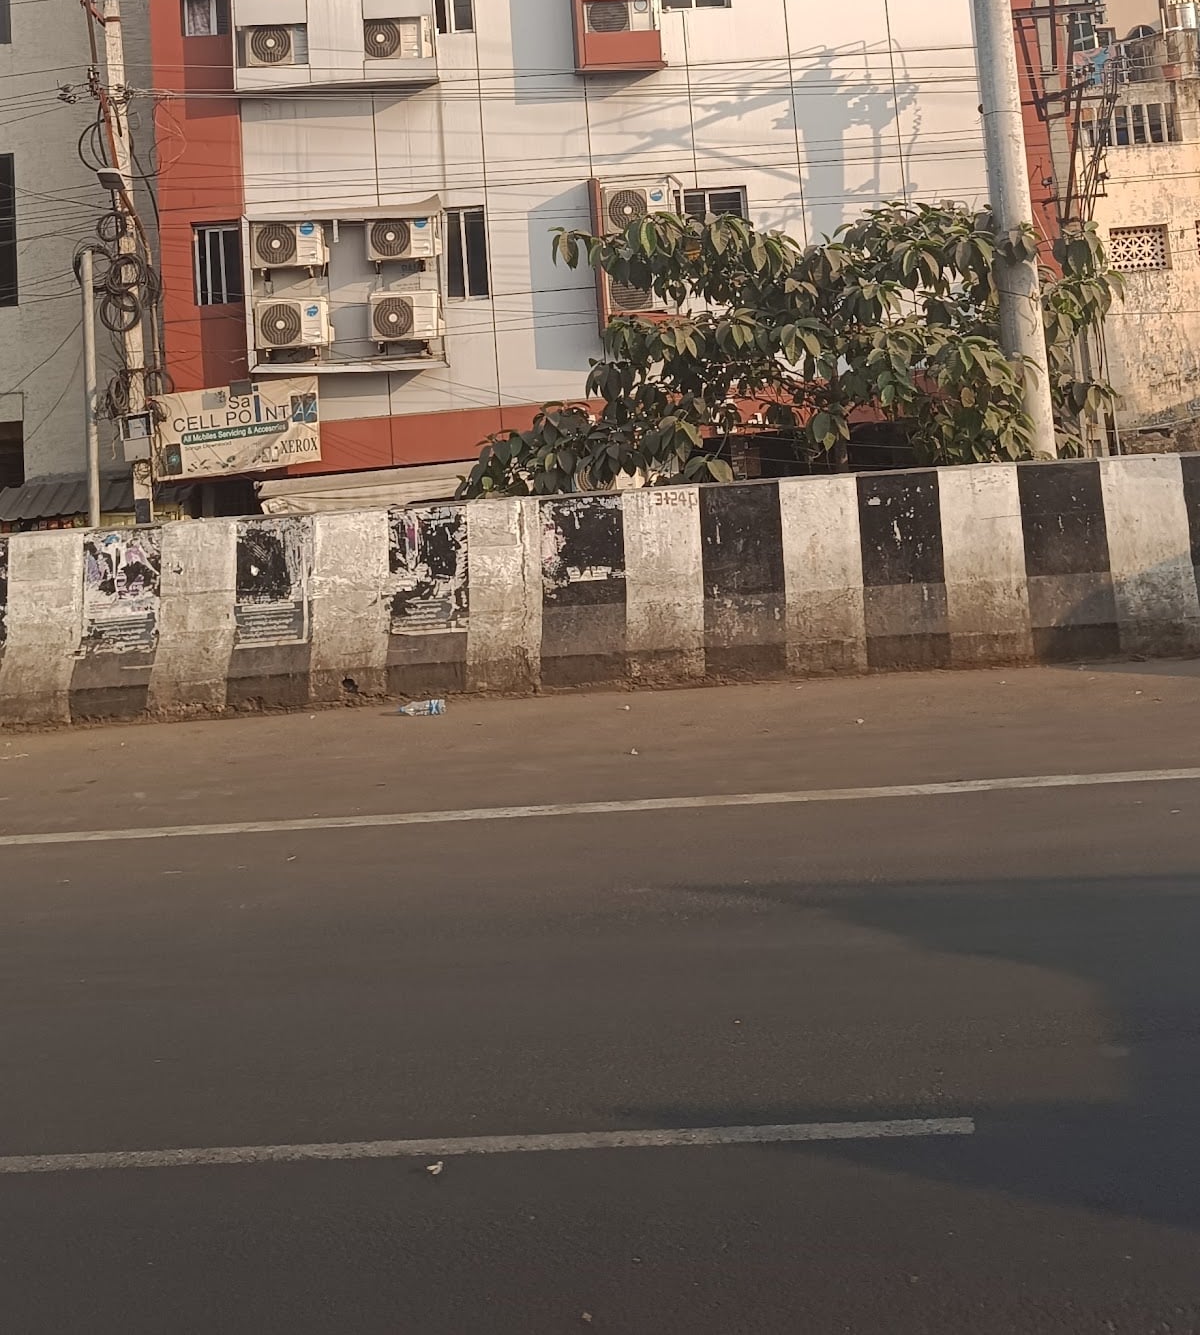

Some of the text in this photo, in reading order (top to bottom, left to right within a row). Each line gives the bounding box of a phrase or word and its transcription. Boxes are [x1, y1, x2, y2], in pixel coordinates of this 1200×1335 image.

[173, 413, 220, 433] CELL
[183, 434, 192, 443] All
[192, 432, 217, 442] Mobiles
[217, 429, 247, 439] Servicing
[247, 427, 253, 435] &
[280, 437, 318, 455] XEROX
